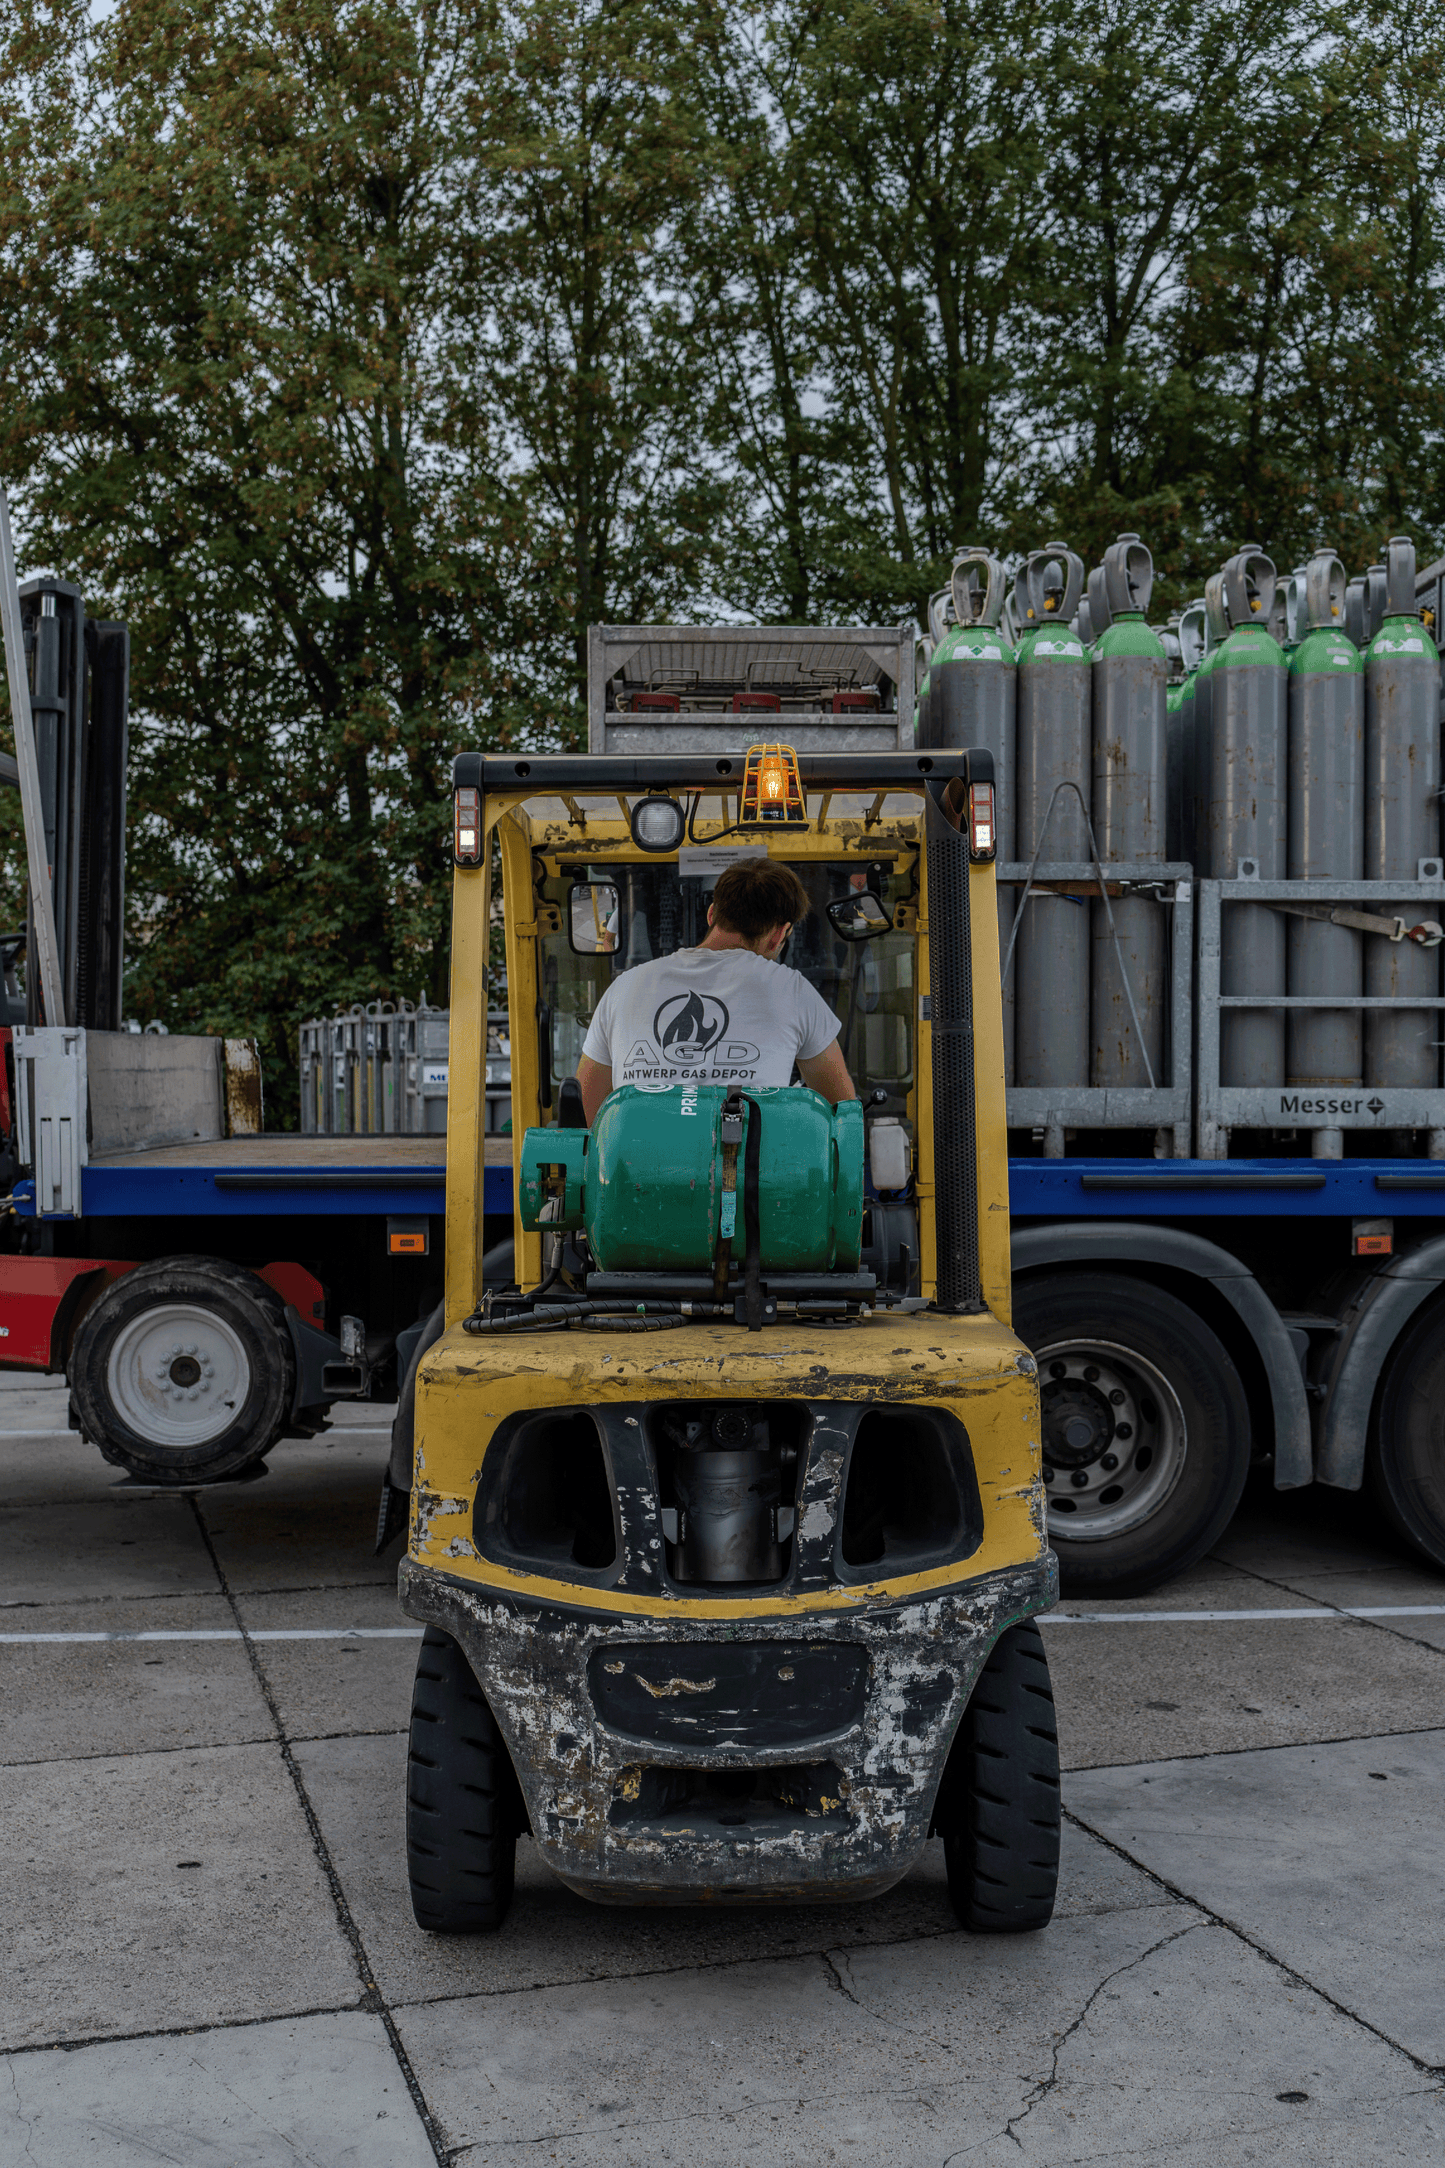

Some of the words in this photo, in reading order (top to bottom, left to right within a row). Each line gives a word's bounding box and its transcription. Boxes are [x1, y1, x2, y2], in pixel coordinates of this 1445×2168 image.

[623, 1039, 761, 1068] AGD
[623, 1068, 678, 1080] ANTWERP
[681, 1068, 707, 1079] GAS
[711, 1068, 757, 1080] DEPOT
[1280, 1095, 1363, 1114] Messer
